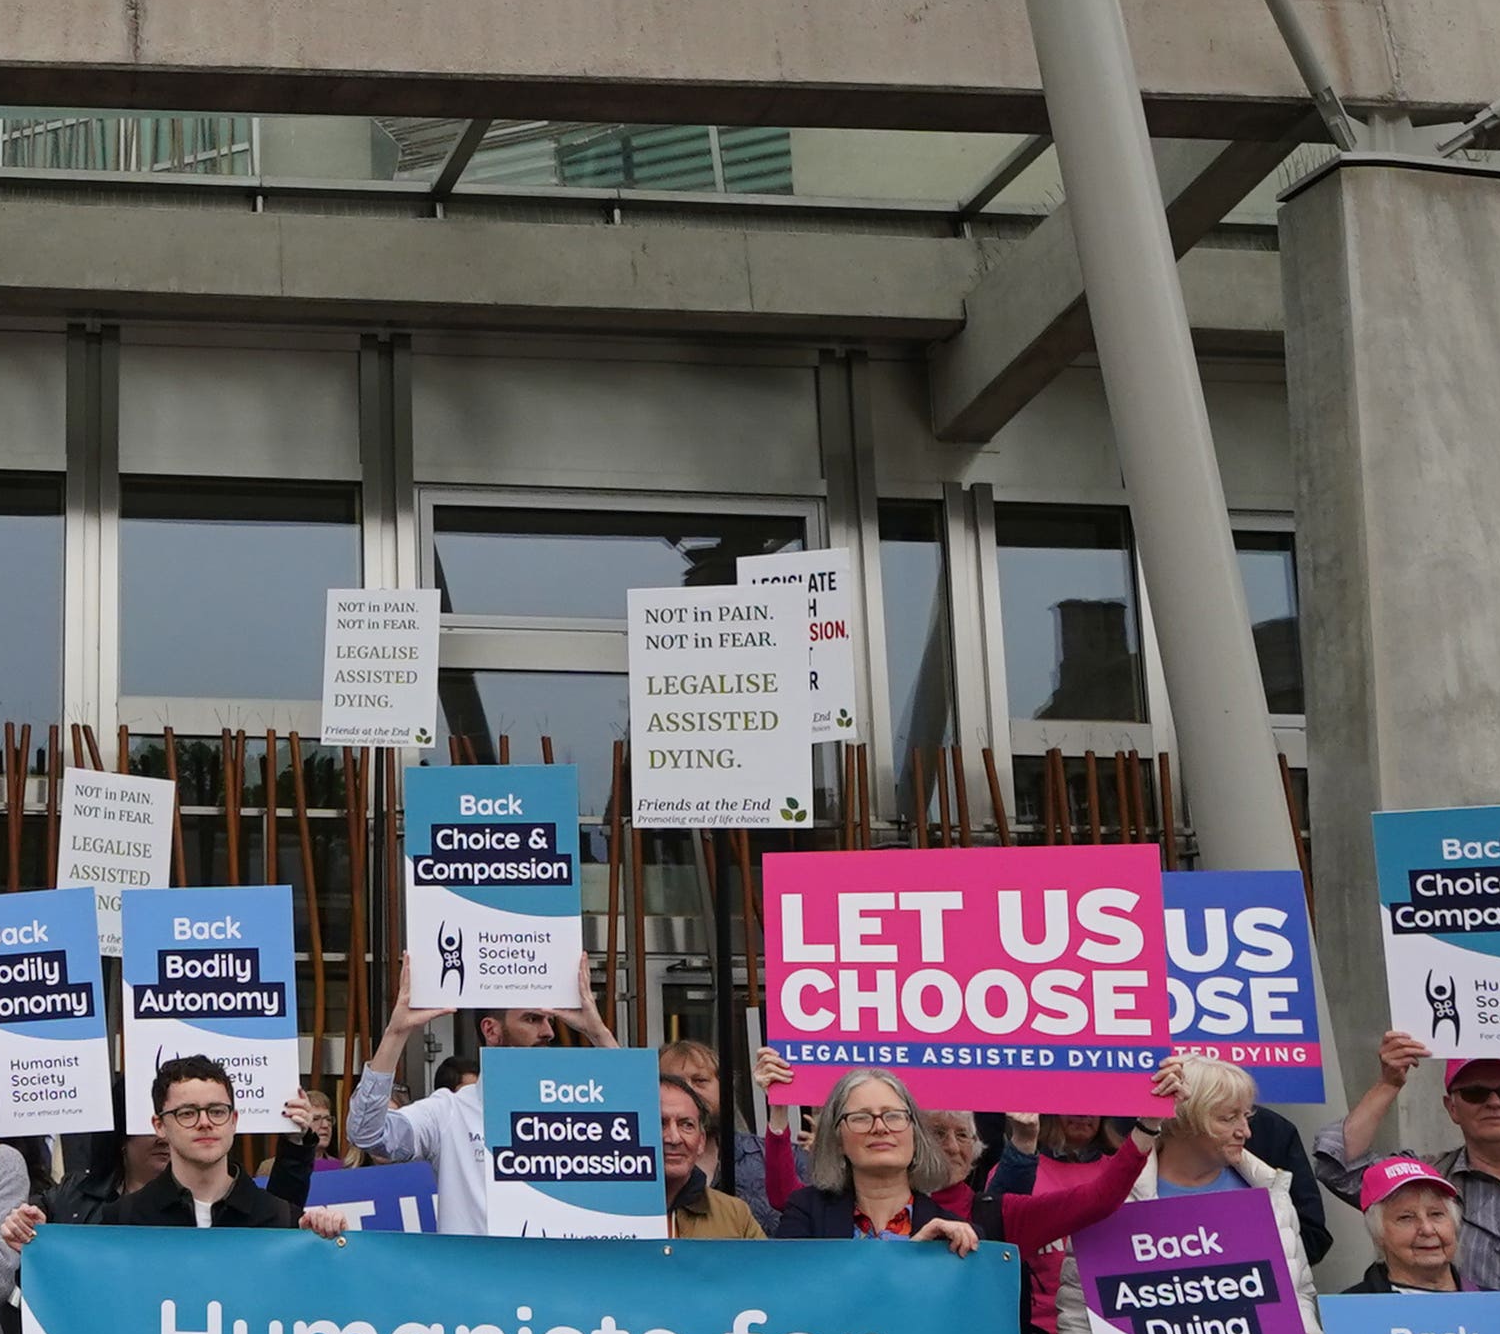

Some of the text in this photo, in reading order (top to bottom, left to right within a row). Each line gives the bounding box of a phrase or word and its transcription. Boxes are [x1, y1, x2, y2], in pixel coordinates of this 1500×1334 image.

[645, 606, 774, 624] NOT in PAIN.
[646, 632, 776, 649] NOT in FEAR.
[647, 673, 778, 695] LEGALISE
[646, 711, 778, 732] ASSISTED
[649, 749, 741, 769] DYING.
[459, 794, 522, 815] Back
[638, 798, 771, 812] Friends at the End
[638, 815, 770, 826] Promoting end of life choices
[435, 828, 548, 851] Choice &
[416, 857, 568, 885] Compassion
[780, 887, 1144, 964] LET US
[780, 967, 1153, 1036] CHOOSE
[786, 1044, 1155, 1069] LEGALISE ASSISTED DYING
[1131, 1226, 1224, 1262] Back
[1114, 1268, 1265, 1311] Assisted
